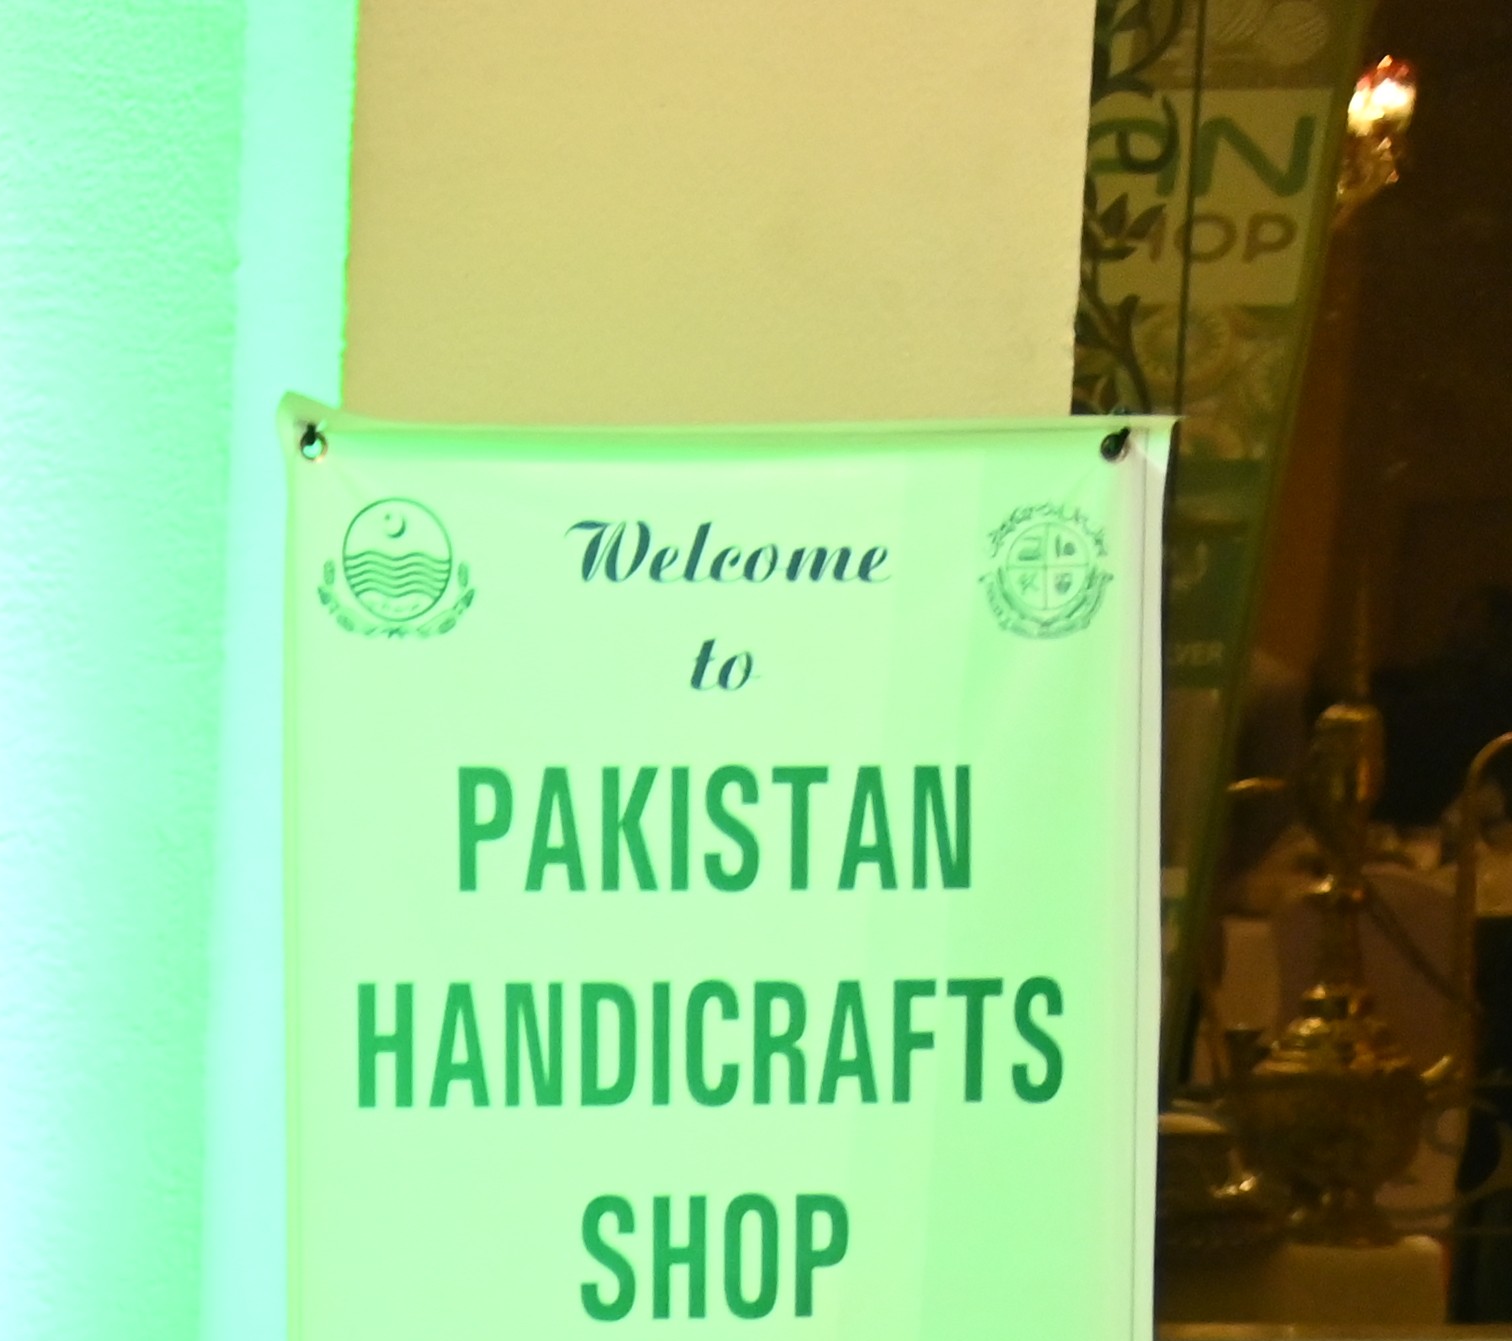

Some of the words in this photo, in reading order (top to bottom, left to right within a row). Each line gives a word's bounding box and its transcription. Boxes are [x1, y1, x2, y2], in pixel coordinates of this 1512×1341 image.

[564, 519, 892, 585] Welcome
[689, 637, 759, 692] to
[457, 763, 972, 894] PAKISTAN
[356, 974, 1066, 1110] HANDICRAFTS
[579, 1192, 851, 1323] SHOP
